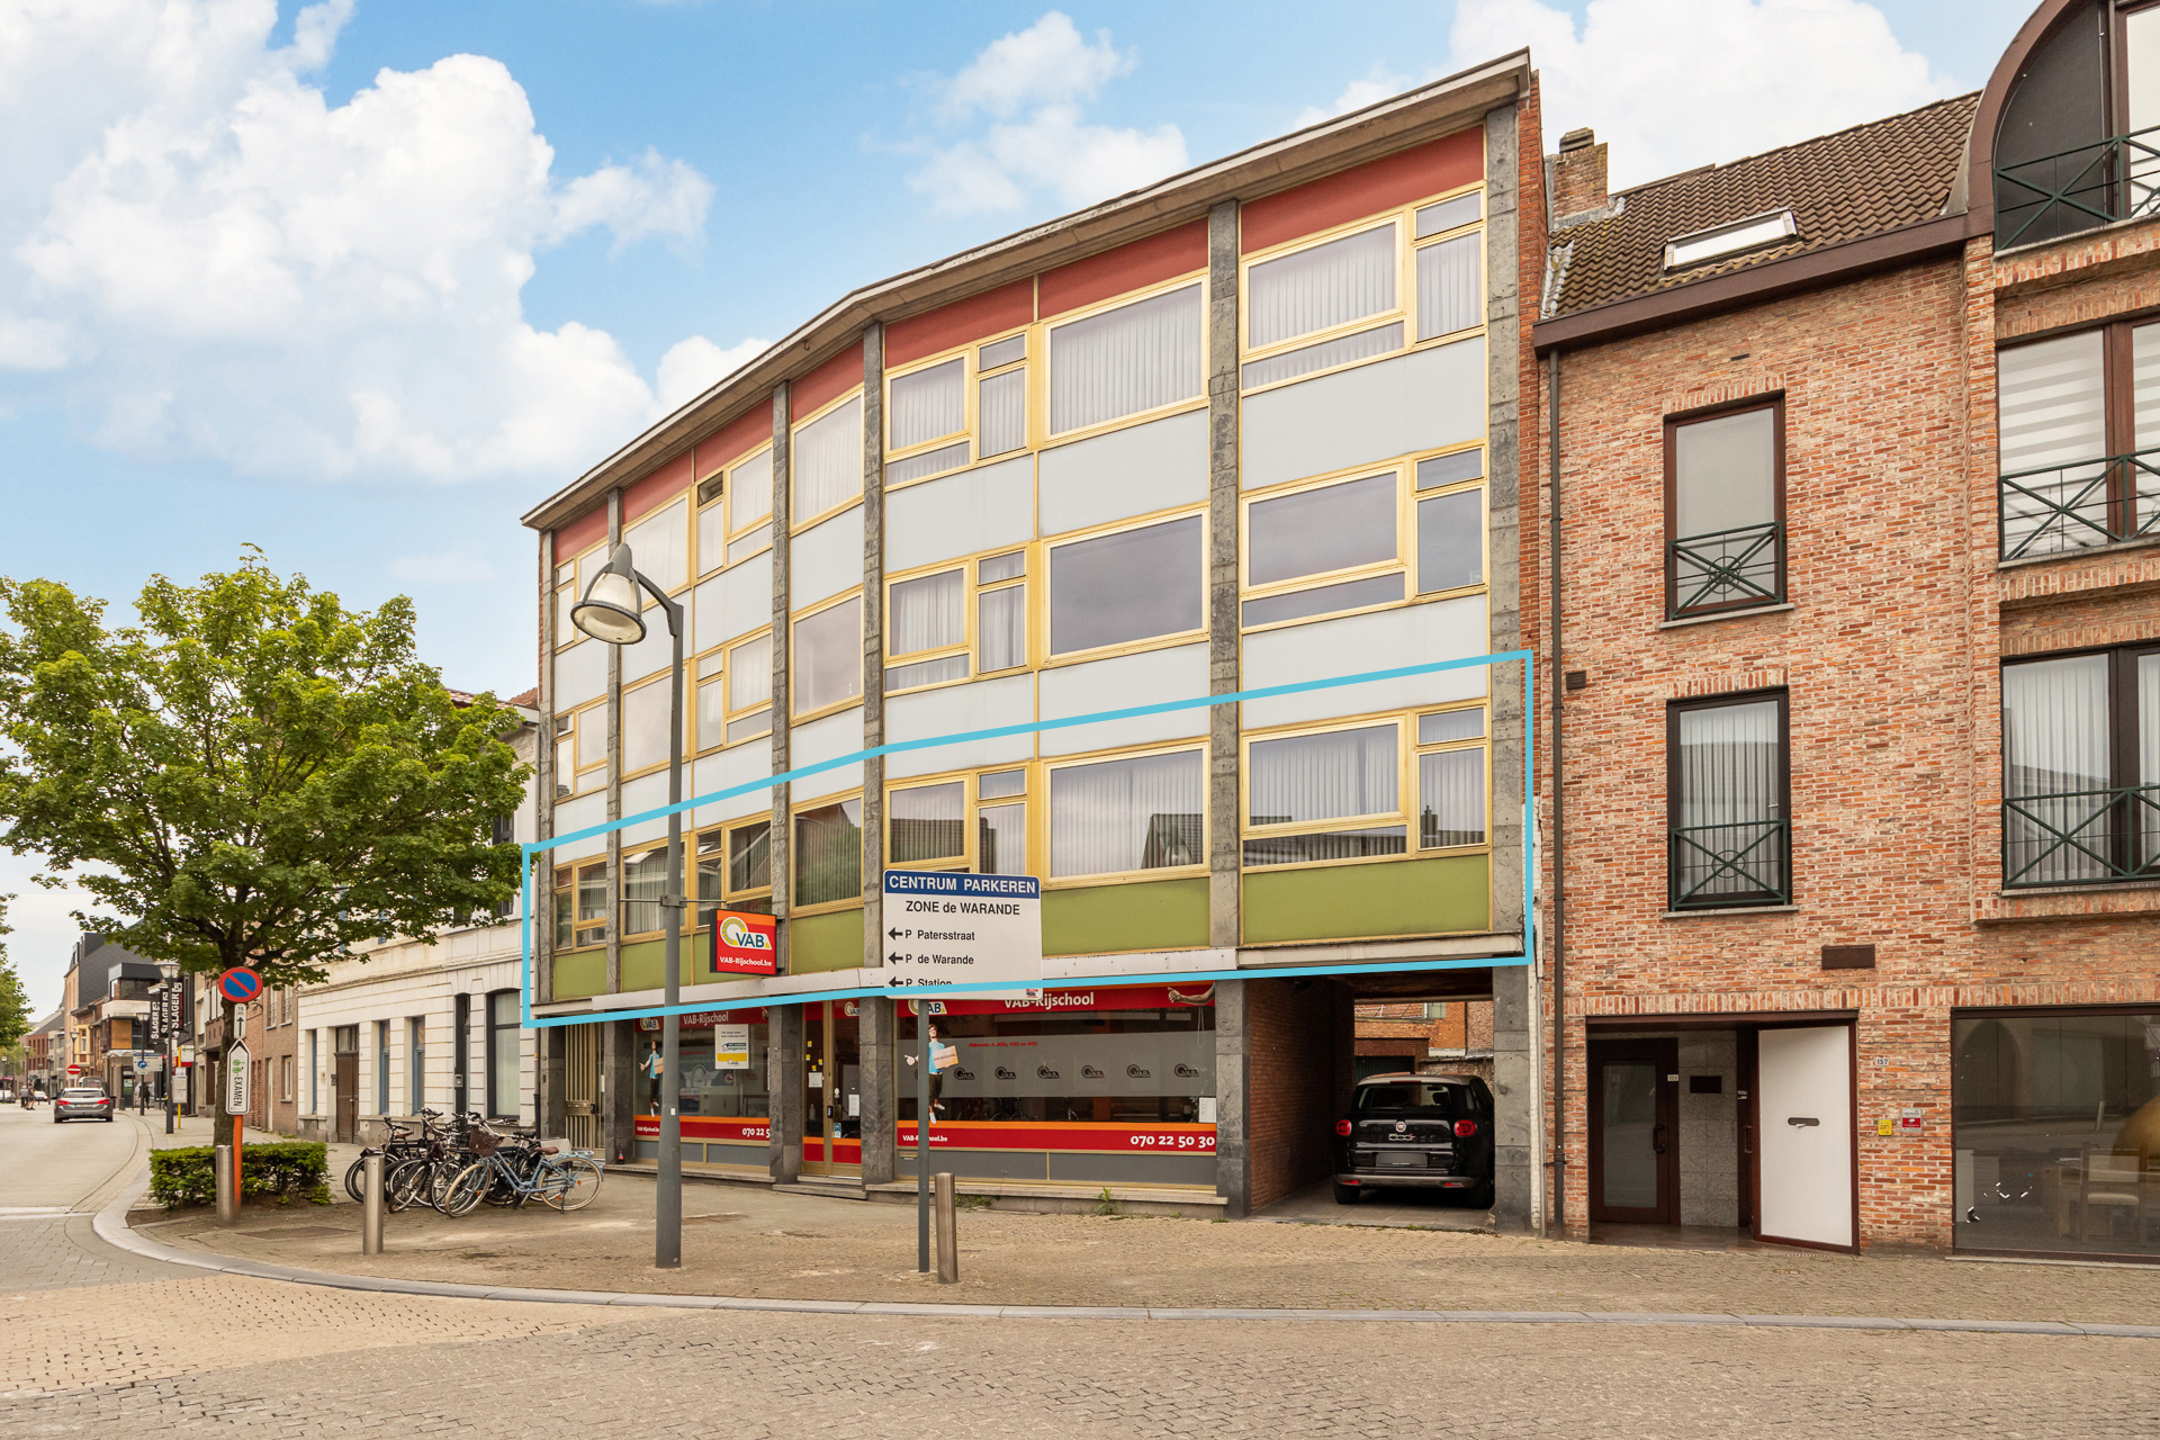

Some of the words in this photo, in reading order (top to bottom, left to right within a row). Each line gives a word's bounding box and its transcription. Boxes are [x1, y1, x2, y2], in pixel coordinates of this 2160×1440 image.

[889, 875, 957, 891] CENTRUM
[963, 878, 1036, 894] PARKEREN
[905, 900, 940, 913] ZONE
[942, 902, 957, 914] de
[960, 903, 1020, 915] WARANDE
[735, 932, 765, 948] VAB
[905, 929, 912, 939] P
[917, 930, 975, 941] Patersstraat
[719, 956, 772, 967] VAB-Rijschool.be
[905, 954, 912, 963] P
[917, 954, 930, 964] de
[932, 954, 974, 965] Warande
[906, 978, 913, 987] P
[1004, 991, 1094, 1010] VAB-Rijschool
[171, 993, 180, 1029] SLAGER
[683, 1011, 729, 1026] VAB-Rijschool
[234, 1076, 243, 1107] EXAMEN
[742, 1127, 755, 1138] 070
[756, 1128, 765, 1136] 22
[1130, 1135, 1155, 1148] 070
[1158, 1135, 1174, 1146] 22
[1178, 1136, 1195, 1149] 50
[1198, 1136, 1215, 1149] 30
